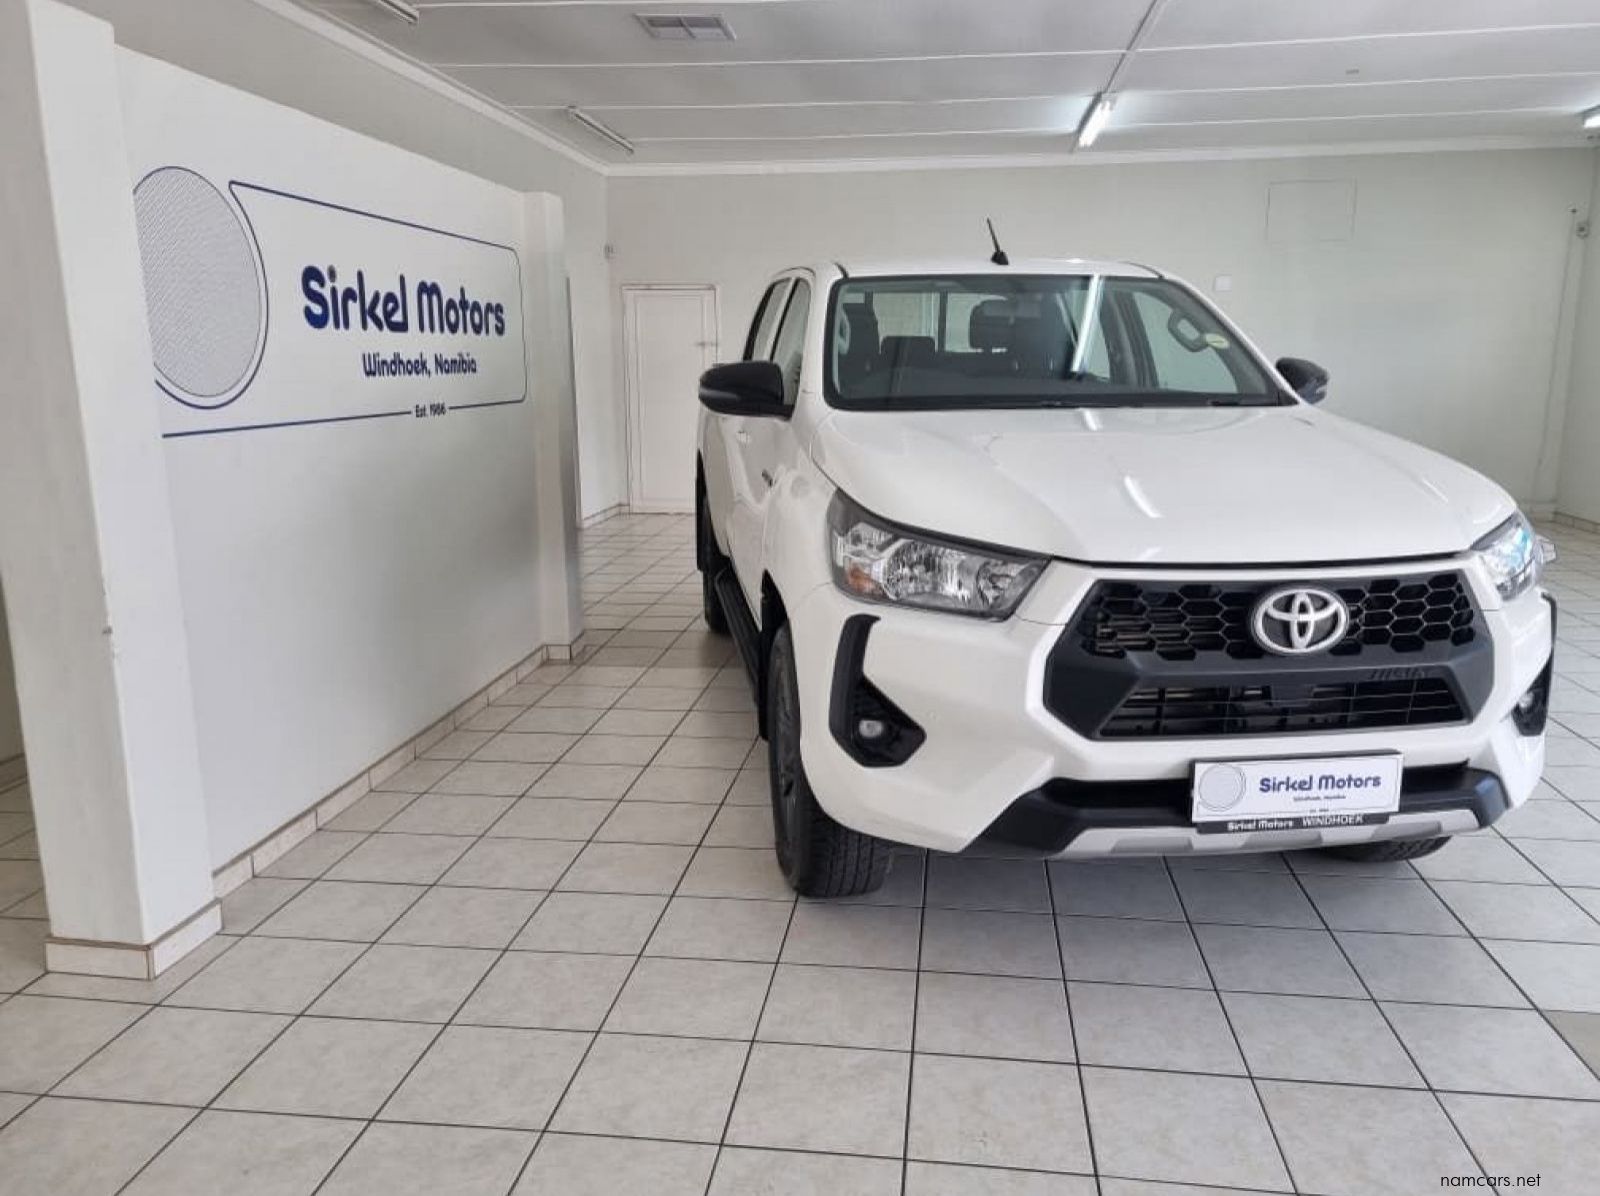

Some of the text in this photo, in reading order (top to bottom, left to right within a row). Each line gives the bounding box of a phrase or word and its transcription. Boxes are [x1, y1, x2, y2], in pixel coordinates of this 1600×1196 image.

[302, 265, 506, 336] Sirkel Motors
[362, 353, 477, 379] Windhoek, Namibia
[1259, 774, 1382, 793] Sirkel Motors
[1227, 821, 1256, 832] Sirkel
[1258, 819, 1293, 830] Motors
